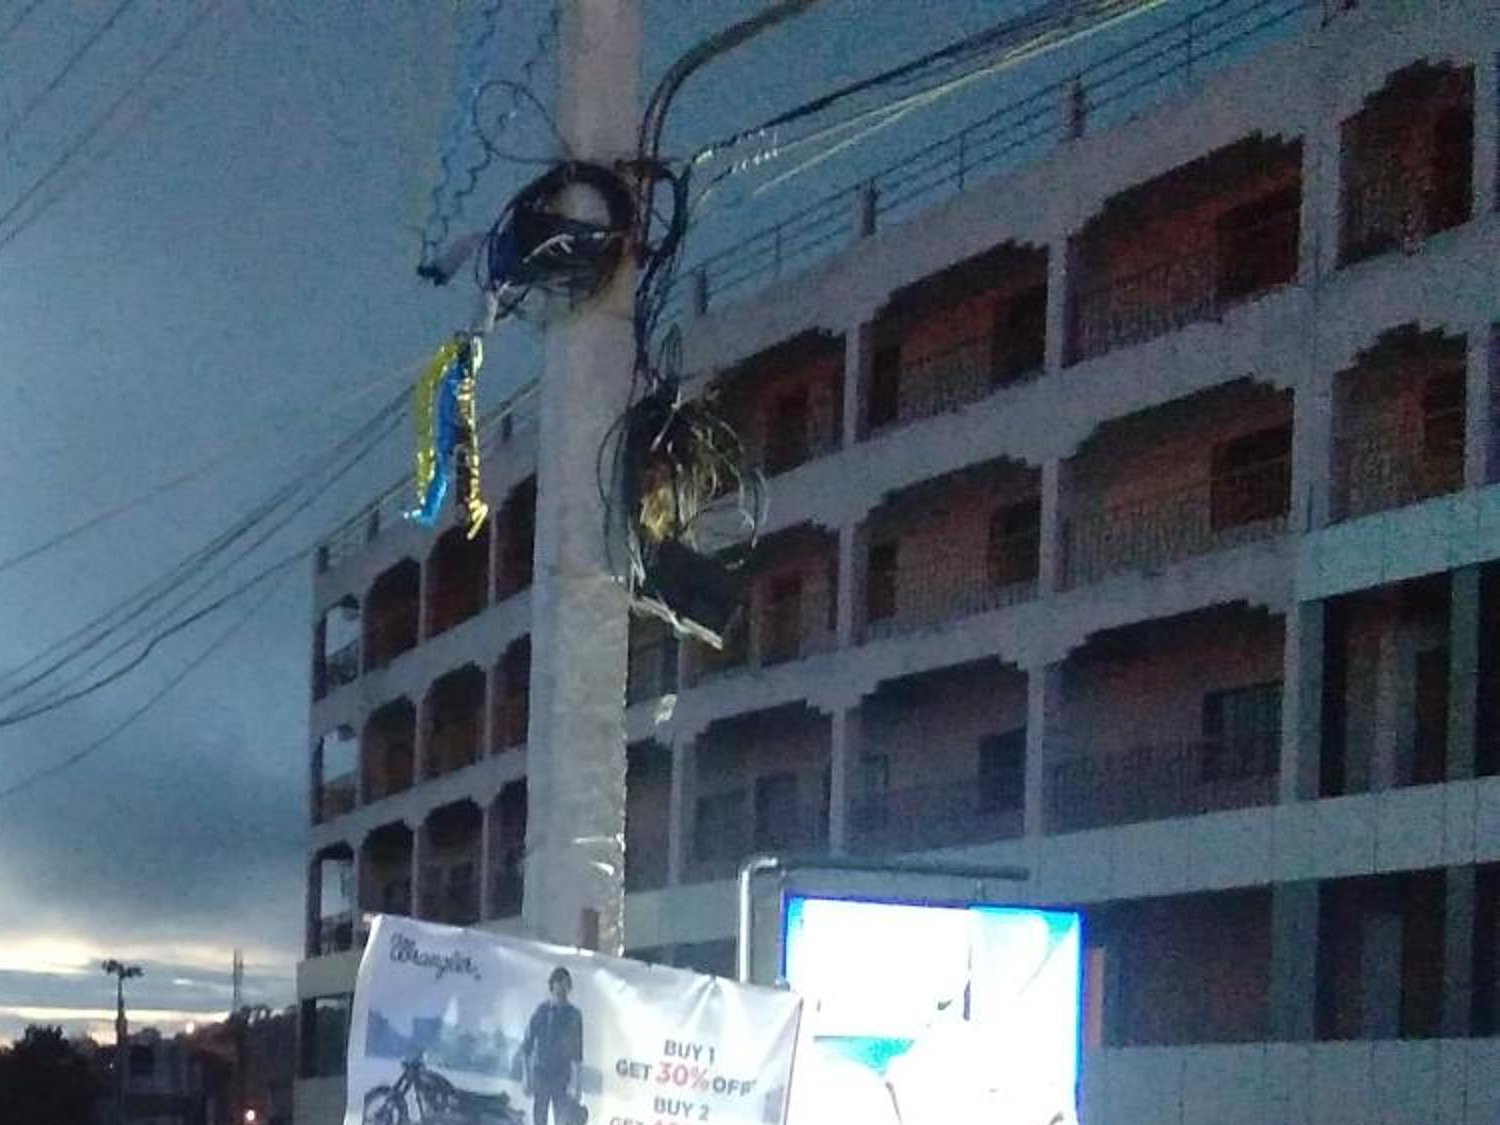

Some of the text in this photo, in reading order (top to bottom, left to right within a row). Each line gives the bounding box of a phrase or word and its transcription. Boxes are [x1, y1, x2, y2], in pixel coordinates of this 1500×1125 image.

[663, 1039, 716, 1065] BUY 1
[615, 1058, 653, 1081] GET
[654, 1061, 710, 1091] 30%
[653, 1096, 710, 1121] BUY 2
